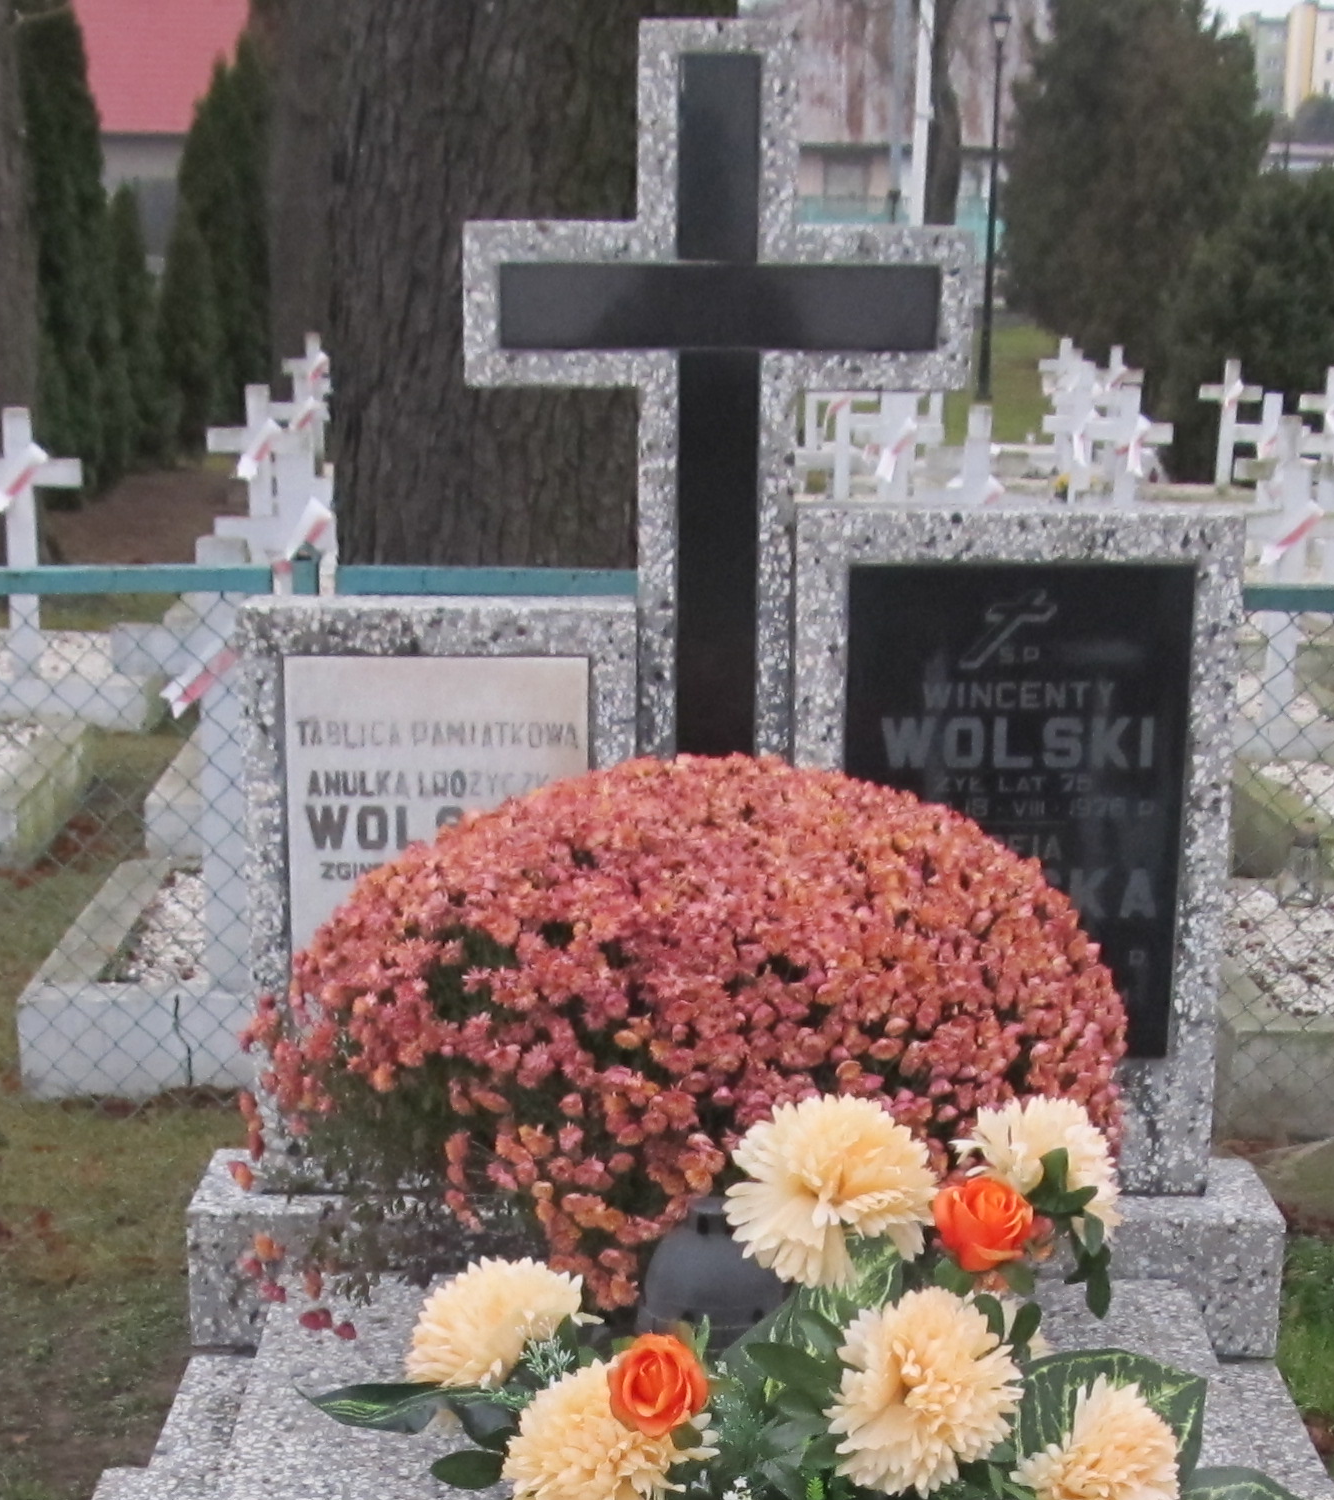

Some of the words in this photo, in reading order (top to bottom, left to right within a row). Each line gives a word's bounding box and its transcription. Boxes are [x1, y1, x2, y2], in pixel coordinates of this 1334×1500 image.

[923, 681, 1116, 711] WINCENTY
[296, 719, 402, 749] TABLICA
[881, 716, 1156, 770] WOLSKI
[307, 769, 410, 798] ANULKA
[997, 775, 1047, 794] LAT
